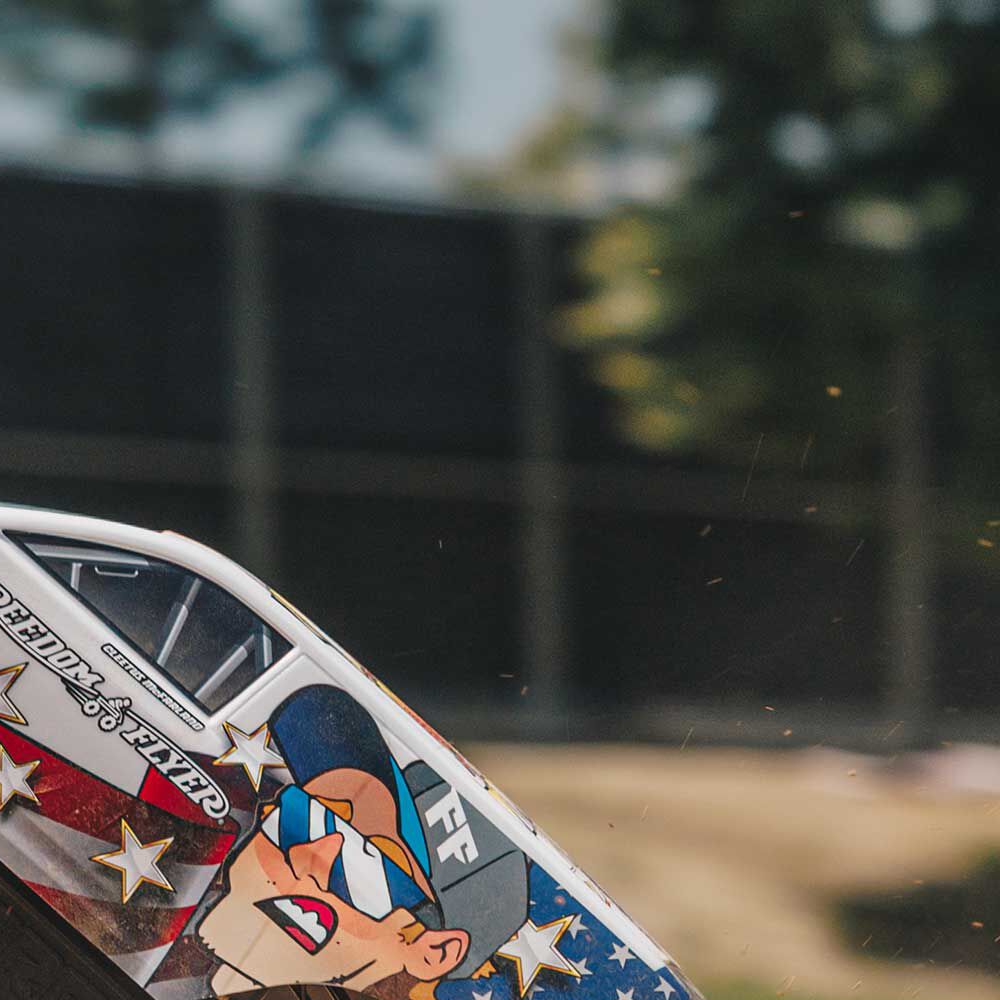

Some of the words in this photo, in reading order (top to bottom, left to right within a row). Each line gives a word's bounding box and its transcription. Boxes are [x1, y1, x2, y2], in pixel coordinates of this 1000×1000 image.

[101, 643, 148, 682] CLEETUS
[119, 716, 231, 820] FLYER
[424, 786, 479, 864] FF
